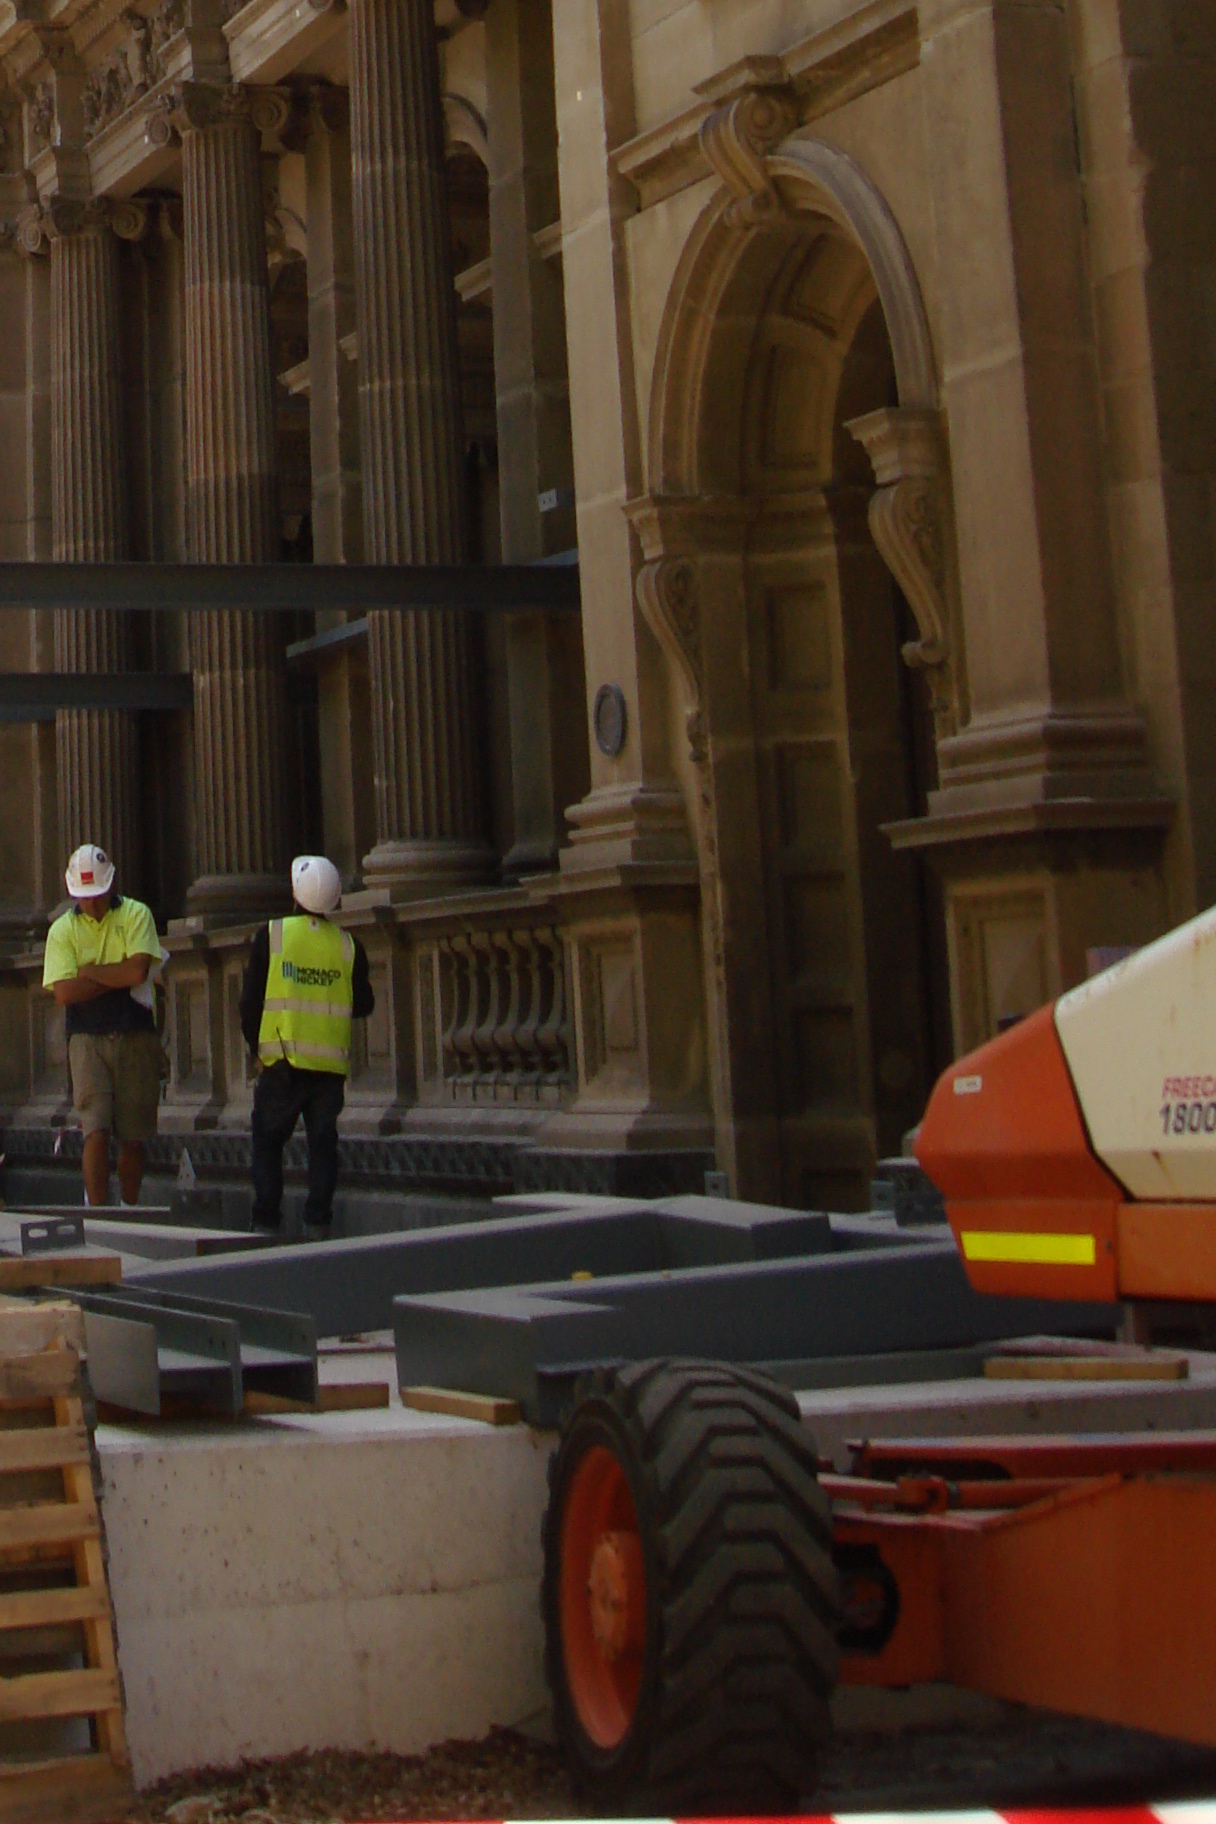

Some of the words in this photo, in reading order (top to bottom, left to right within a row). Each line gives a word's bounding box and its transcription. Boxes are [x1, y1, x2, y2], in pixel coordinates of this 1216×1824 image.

[297, 966, 341, 979] MONACO
[297, 976, 334, 986] HICKEY
[1162, 1074, 1216, 1098] FREEC
[1159, 1101, 1216, 1135] 1800
